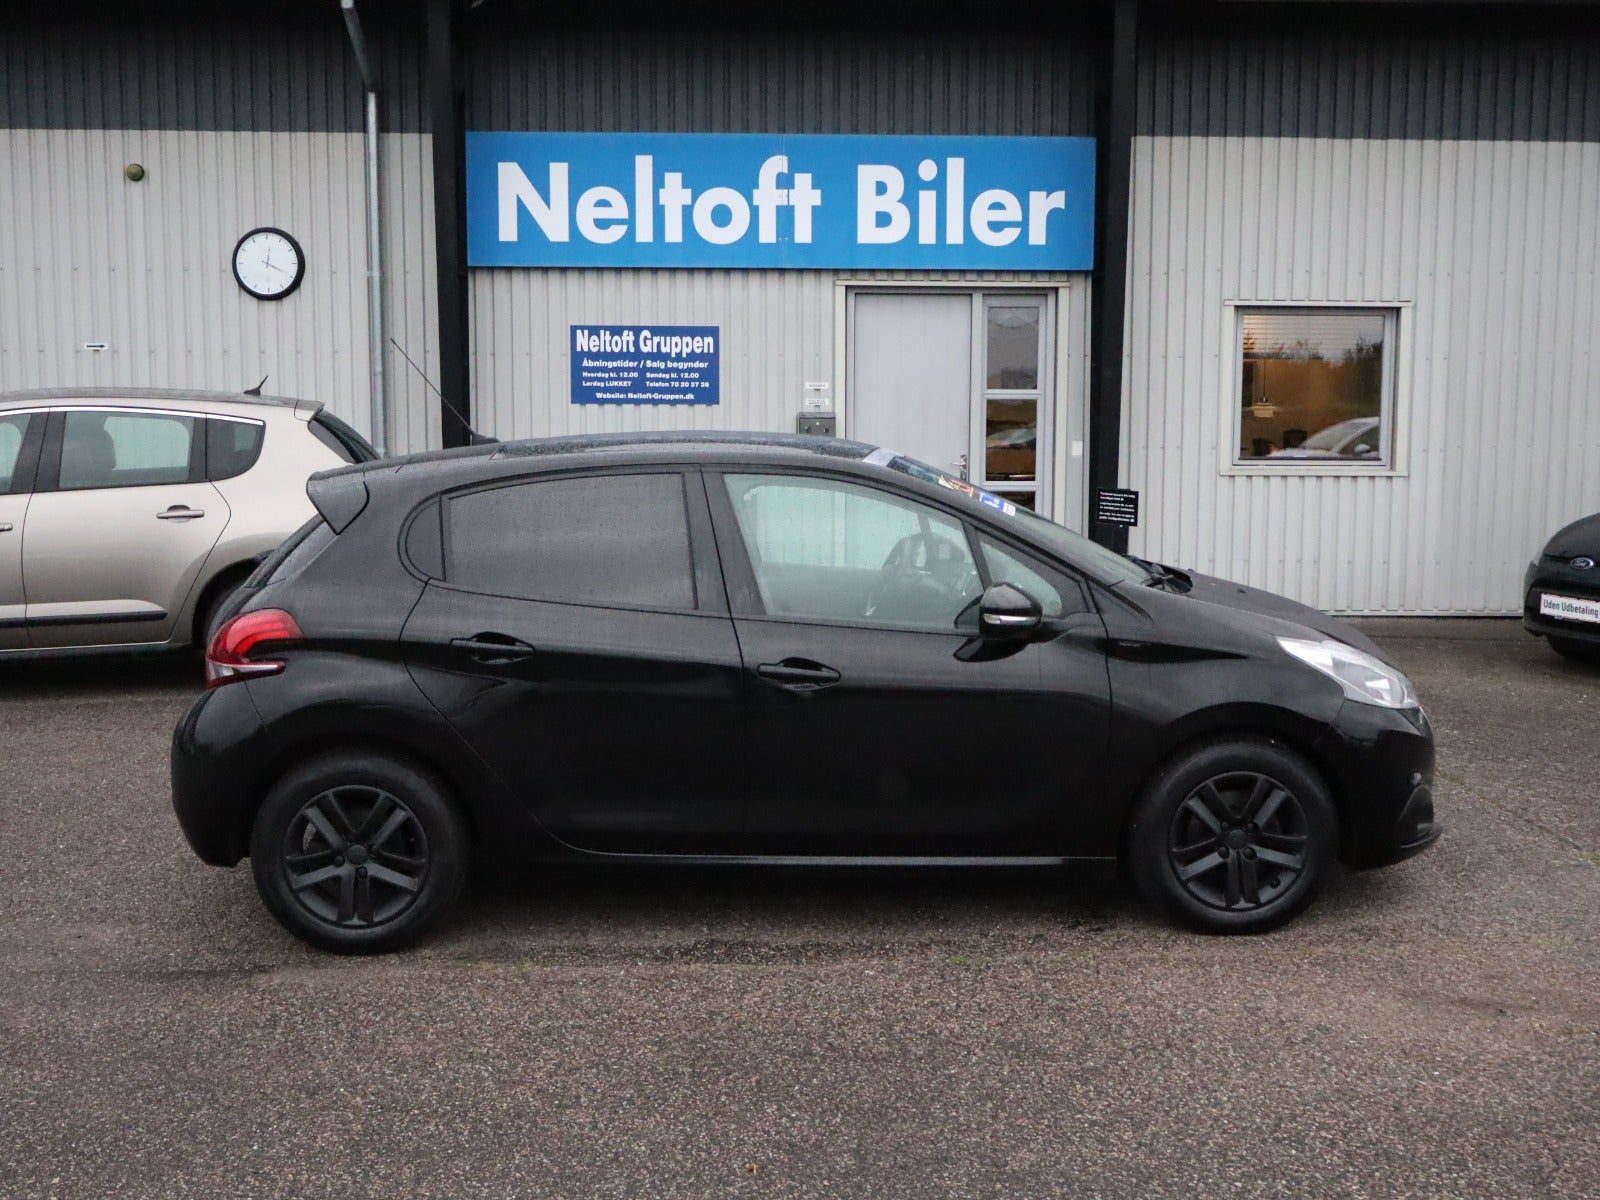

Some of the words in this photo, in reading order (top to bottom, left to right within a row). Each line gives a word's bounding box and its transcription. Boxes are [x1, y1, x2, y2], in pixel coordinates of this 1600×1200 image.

[498, 155, 821, 245] Neltoft
[857, 157, 1066, 246] Biler
[576, 329, 635, 352] Neltoft
[639, 330, 714, 358] Gruppen
[582, 358, 638, 368] Åbningstider
[646, 360, 665, 369] Salg
[667, 361, 708, 369] begynder
[1543, 599, 1560, 610] Uden
[1561, 602, 1599, 618] Udbetaling
